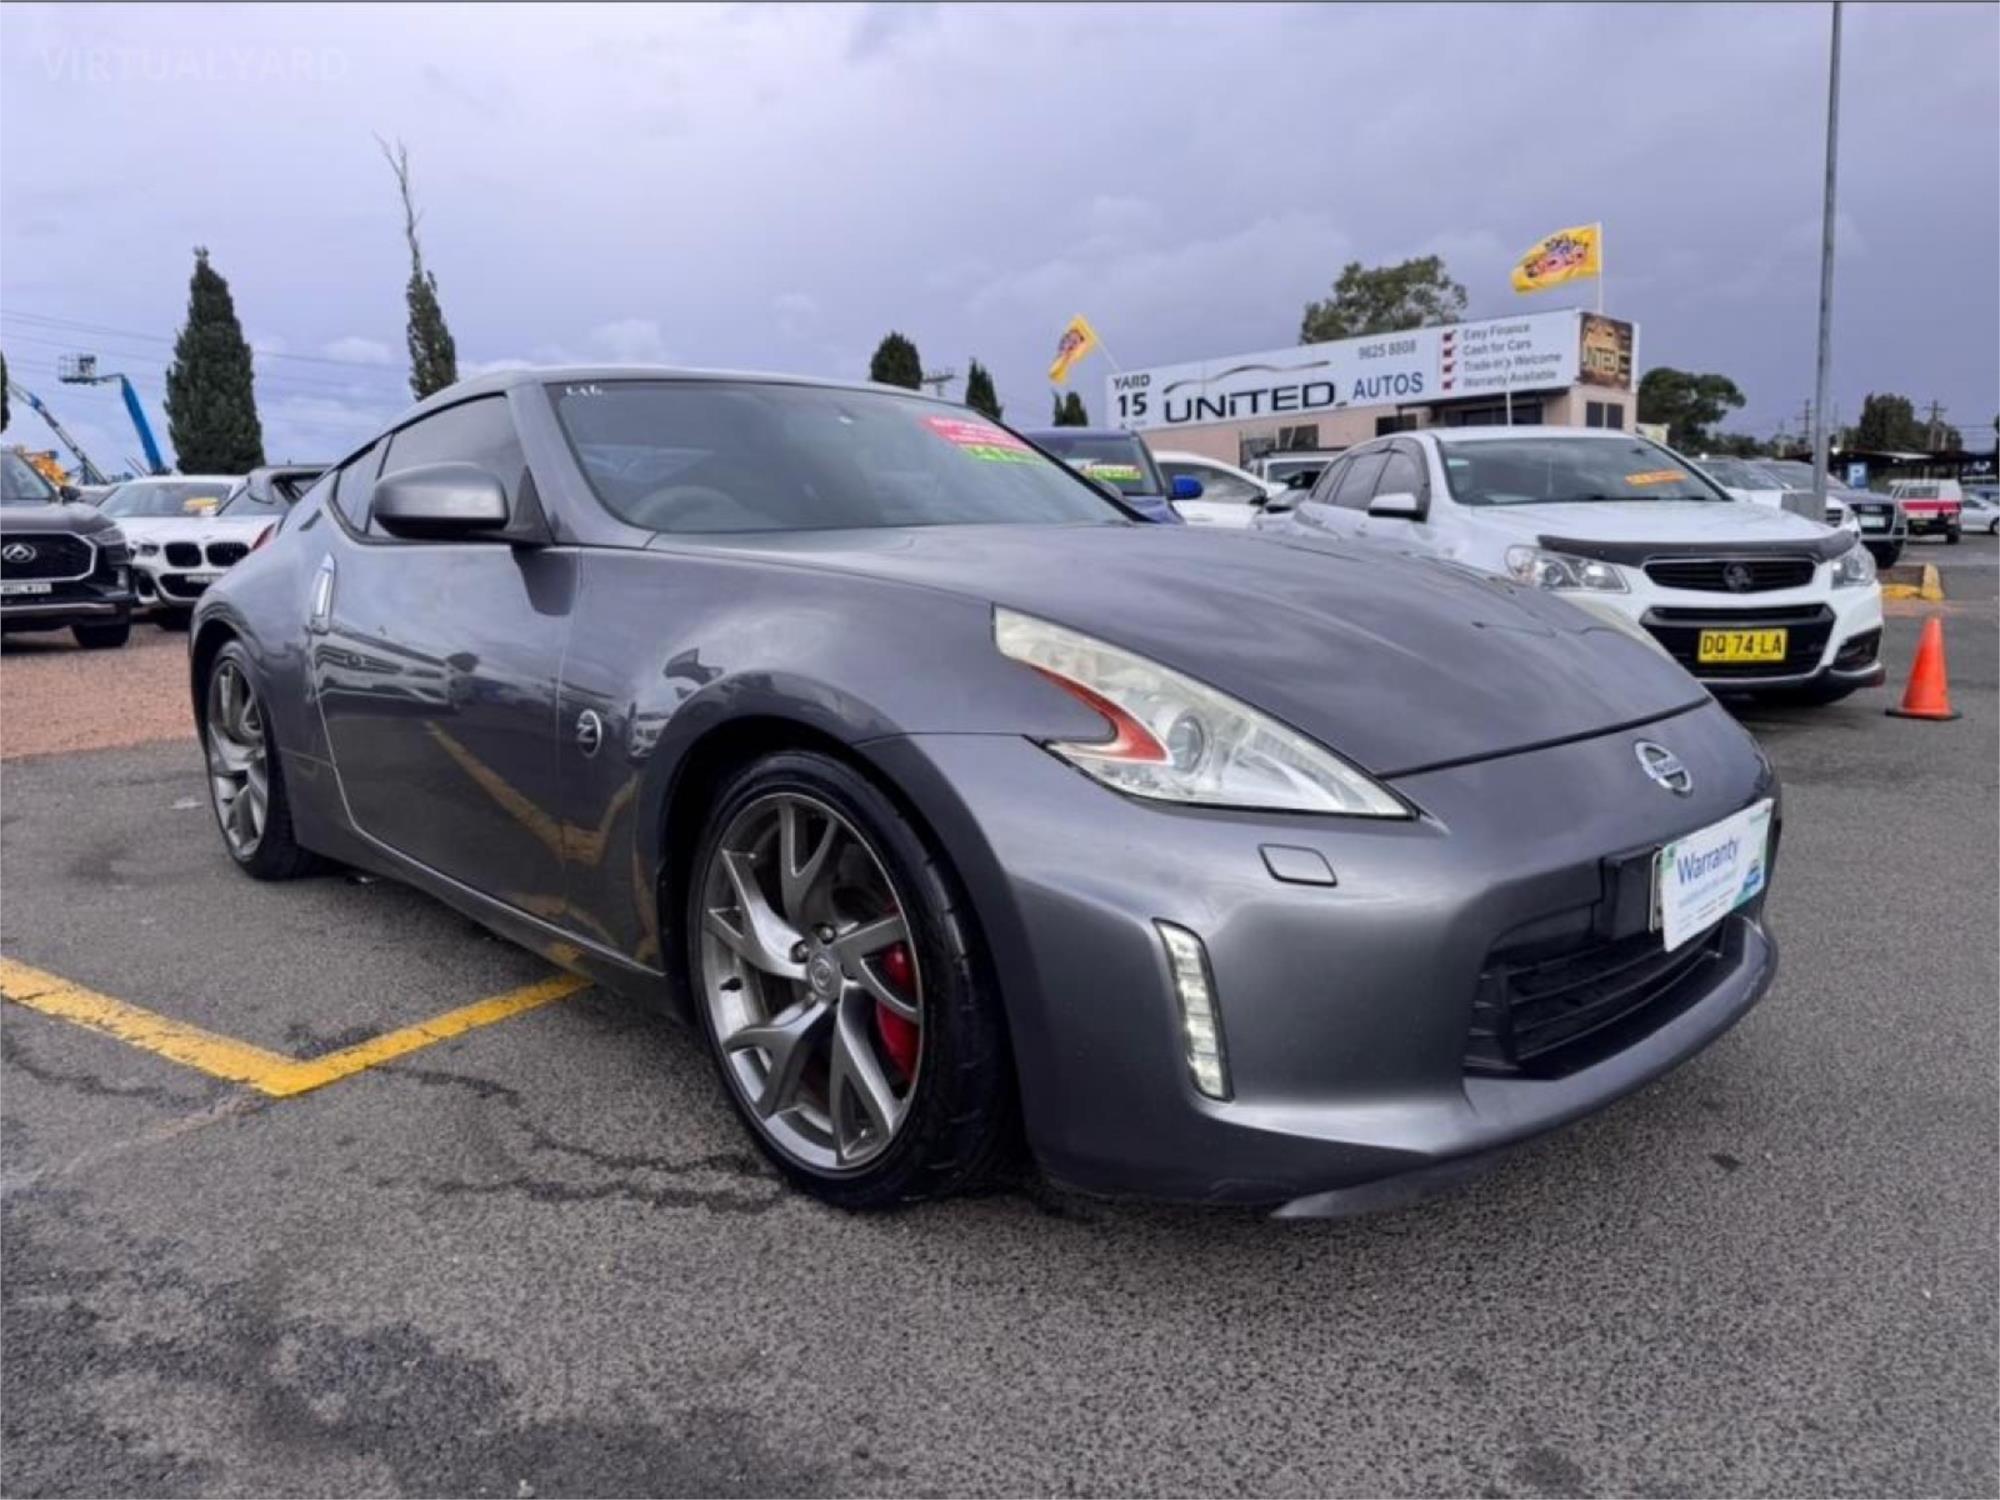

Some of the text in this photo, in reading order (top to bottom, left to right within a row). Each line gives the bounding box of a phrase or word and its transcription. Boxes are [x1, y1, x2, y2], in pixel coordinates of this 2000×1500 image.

[1489, 323, 1531, 337] Finance
[1463, 339, 1532, 356] Cash for Cars
[1513, 353, 1562, 366] Welcome
[1113, 374, 1151, 390] YARD
[1510, 370, 1557, 383] Available
[1118, 392, 1148, 418] 15
[1165, 371, 1424, 423] UNITED AUTOS
[1733, 634, 1755, 654] 74
[1760, 633, 1783, 654] LA
[1677, 838, 1738, 884] Warranty
